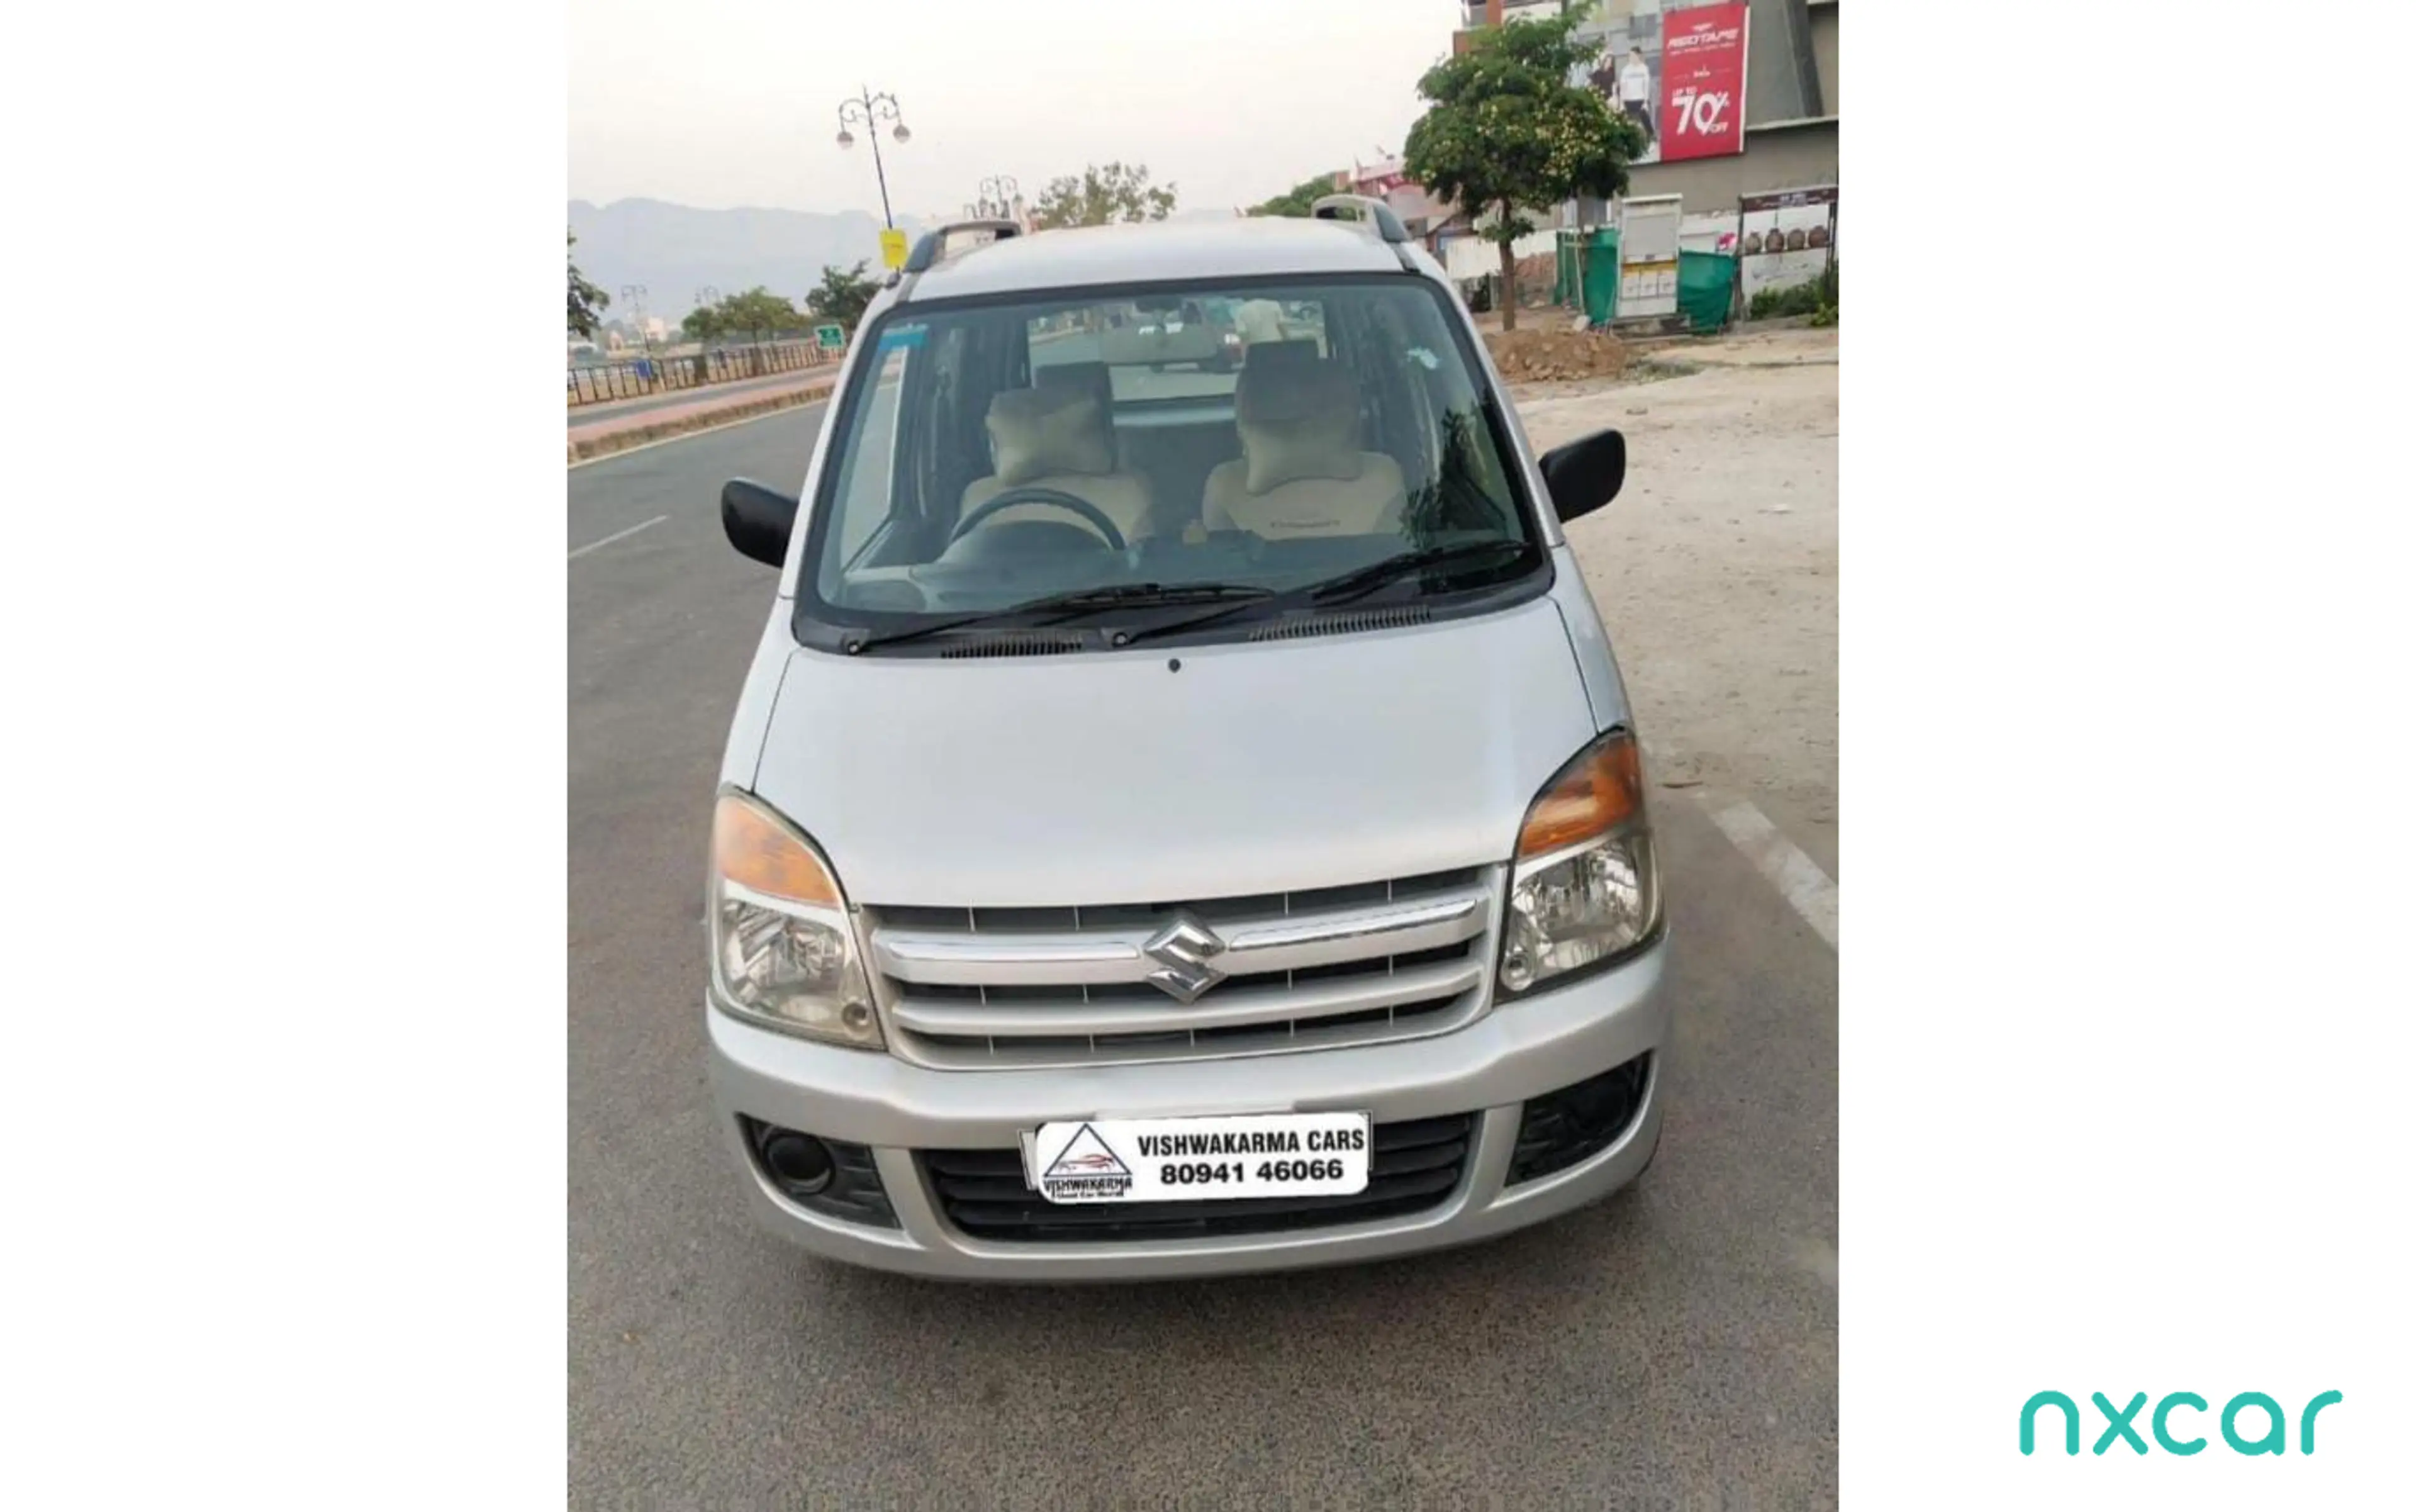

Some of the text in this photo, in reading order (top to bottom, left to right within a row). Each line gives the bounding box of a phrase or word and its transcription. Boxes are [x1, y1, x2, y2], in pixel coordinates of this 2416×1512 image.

[1137, 1129, 1364, 1156] VISHWAKARMA CARS
[1043, 1176, 1132, 1192] VISHWAKARMA
[1160, 1159, 1344, 1184] 80941 46066
